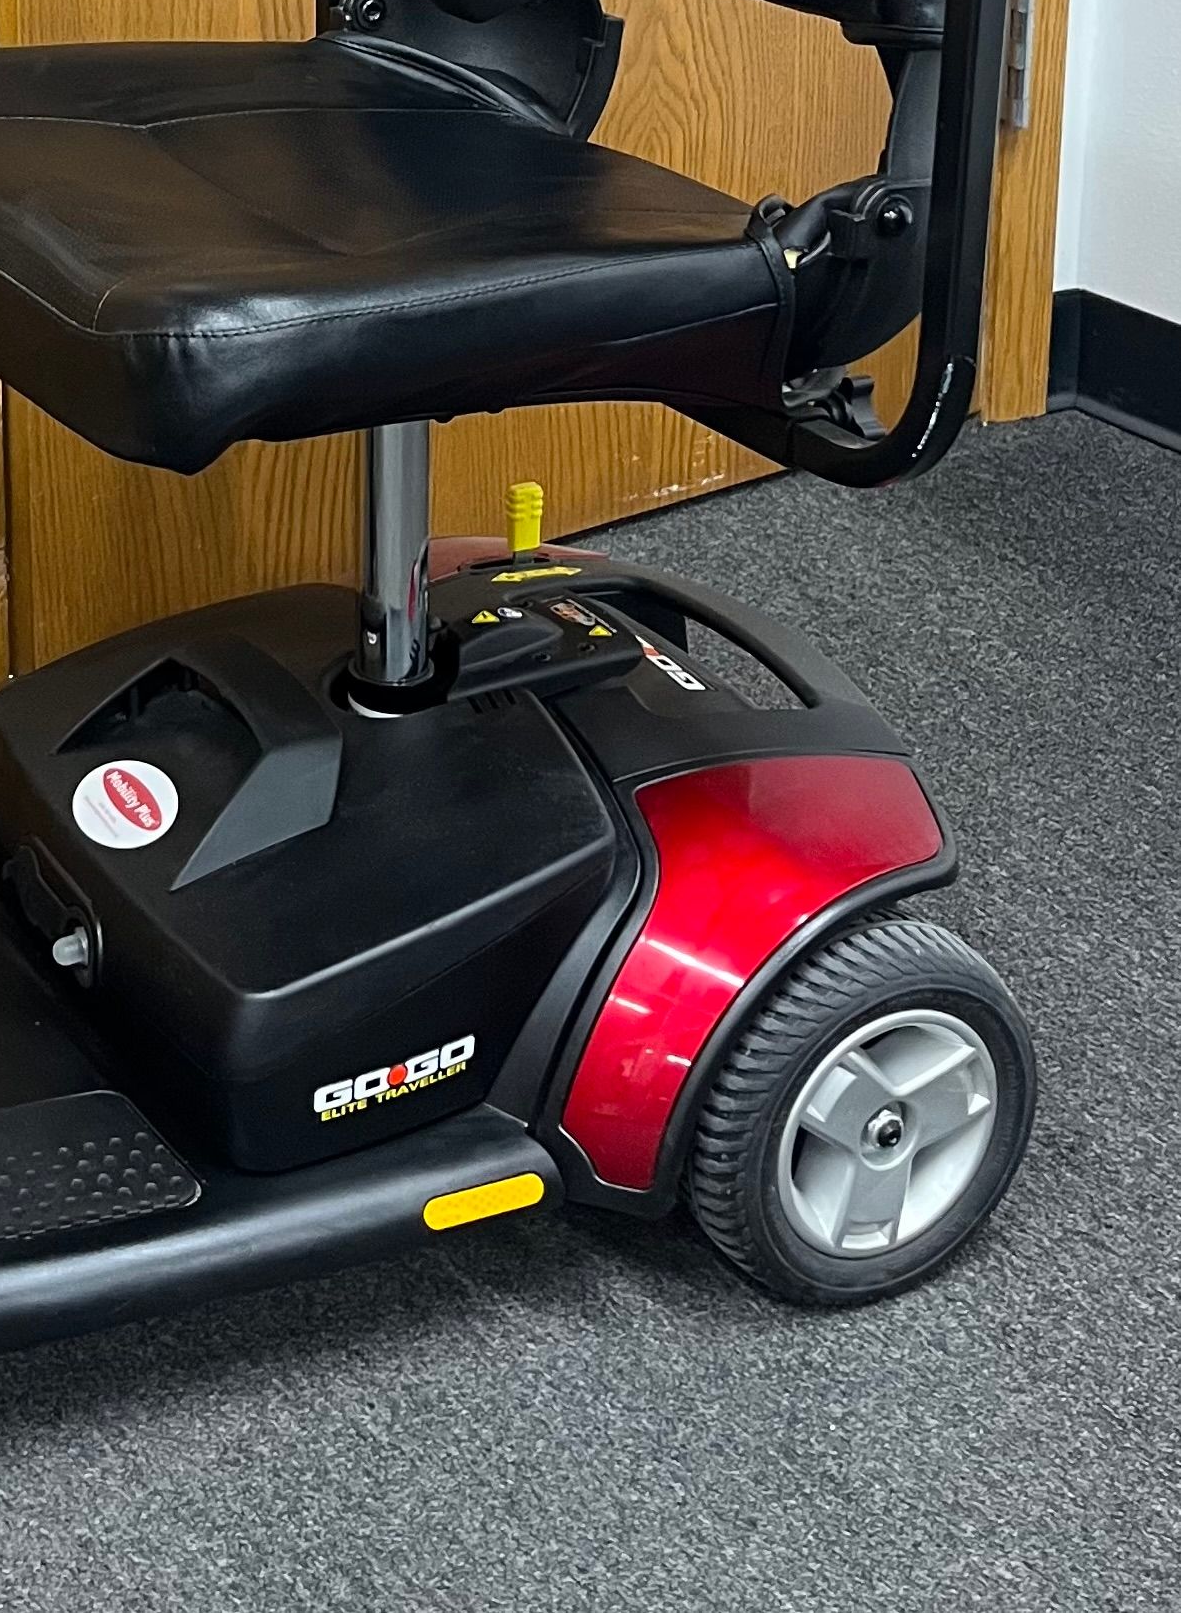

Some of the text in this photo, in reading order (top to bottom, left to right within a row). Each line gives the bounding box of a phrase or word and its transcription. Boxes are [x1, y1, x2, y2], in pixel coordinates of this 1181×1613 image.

[105, 770, 157, 828] Mobility Plus
[321, 1061, 468, 1122] ELITE TRAVELLER
